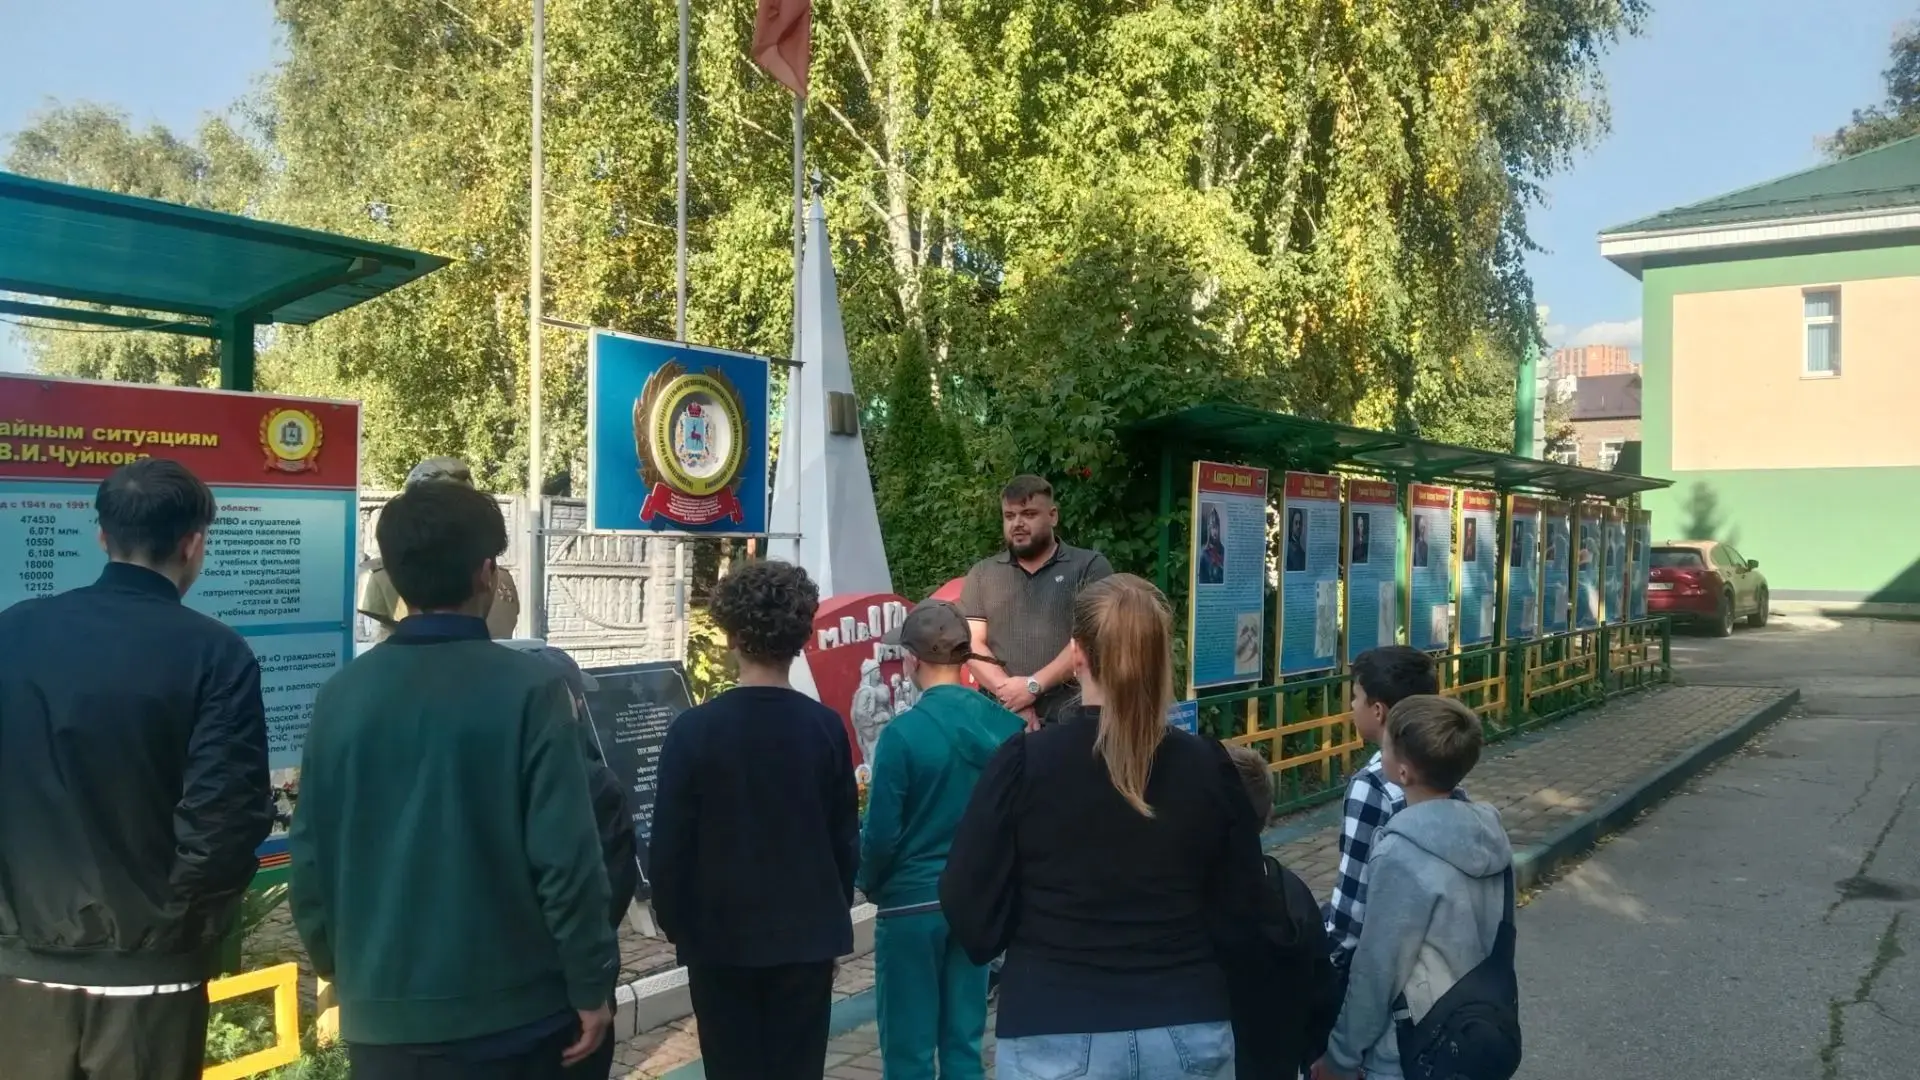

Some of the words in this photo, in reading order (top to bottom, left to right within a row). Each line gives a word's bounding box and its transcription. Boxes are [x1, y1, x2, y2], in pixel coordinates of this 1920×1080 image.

[92, 427, 218, 447] ситуациям
[221, 504, 262, 512] области:
[20, 515, 56, 524] 474530
[249, 518, 301, 527] слушателей
[207, 529, 253, 537] отающего
[223, 539, 274, 547] тренировок
[289, 537, 301, 545] ГО
[25, 560, 54, 569] 18000
[219, 557, 258, 566] учебных
[260, 558, 300, 566] фильмов
[19, 571, 54, 580] 160000
[204, 568, 231, 577] бесед
[241, 568, 301, 577] консультаций
[249, 577, 301, 586] радиобесед
[25, 582, 54, 591] 12125
[203, 588, 273, 597] патриотических
[275, 588, 300, 596] акций
[242, 597, 270, 605] статей
[281, 596, 300, 605] СМИ
[217, 606, 255, 617] учебных
[258, 606, 300, 616] программ
[282, 651, 336, 662] гражданской
